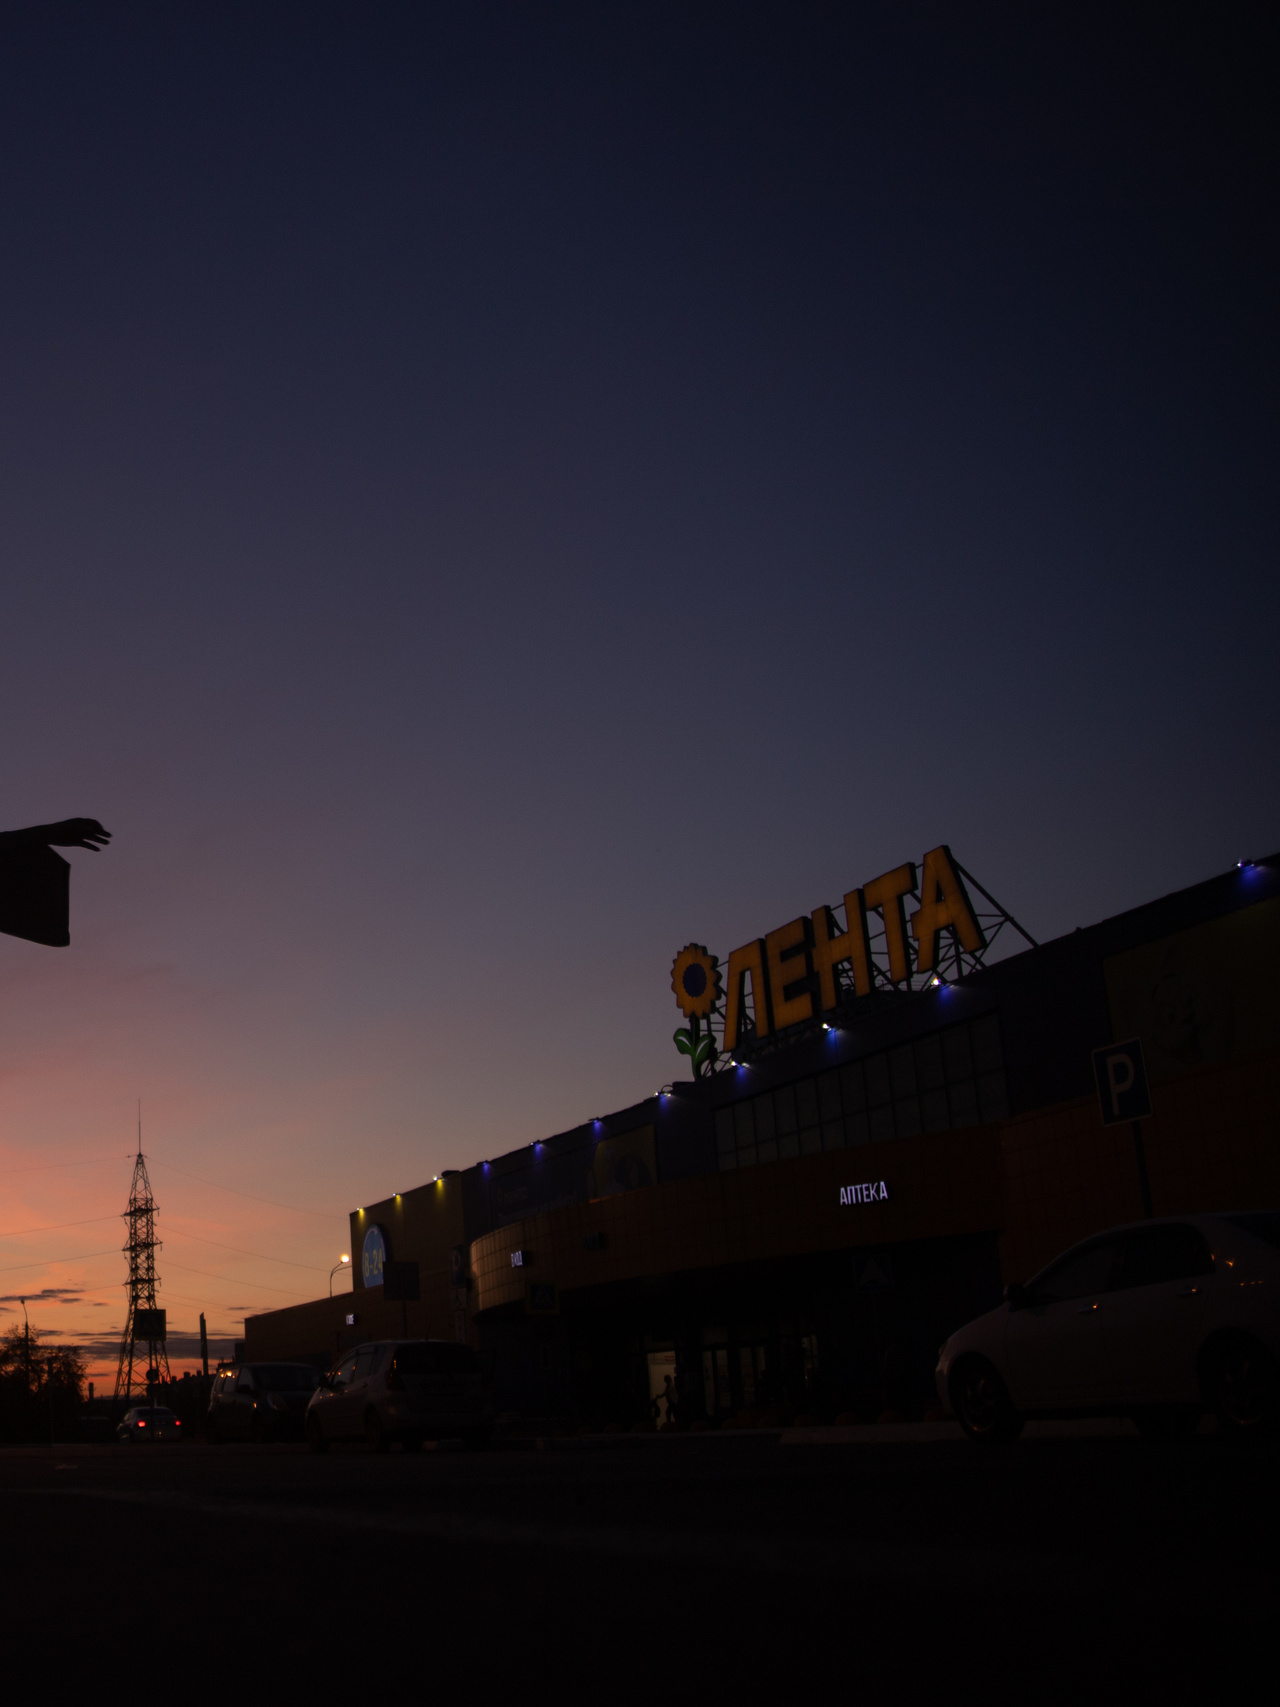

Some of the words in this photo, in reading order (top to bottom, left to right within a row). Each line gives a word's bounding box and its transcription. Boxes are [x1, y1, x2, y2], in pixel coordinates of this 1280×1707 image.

[723, 845, 987, 1051] ЛЕНТА
[1105, 1053, 1135, 1117] P
[840, 1181, 888, 1206] АПТЕКА
